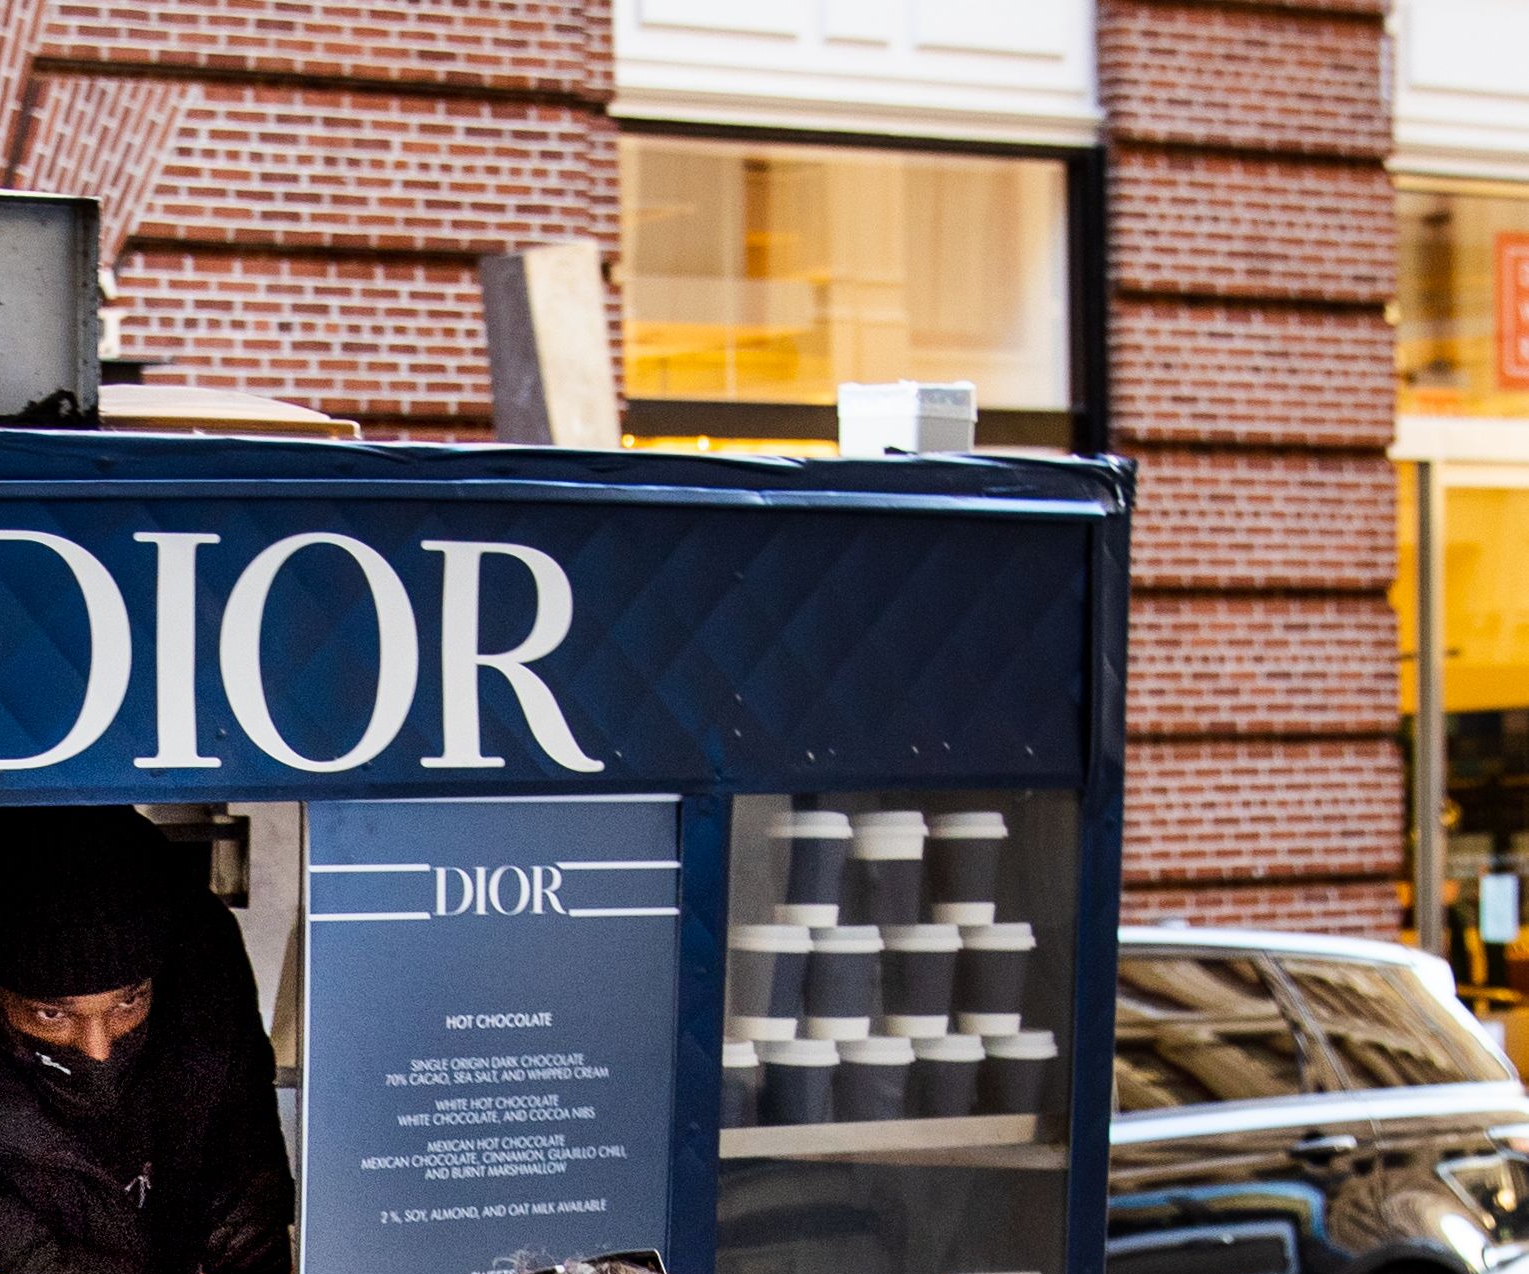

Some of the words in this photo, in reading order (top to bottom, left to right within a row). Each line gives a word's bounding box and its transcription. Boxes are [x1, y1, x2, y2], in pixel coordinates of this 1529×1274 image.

[434, 866, 570, 916] DIOR
[445, 1014, 473, 1030] HOT
[475, 1012, 553, 1029] CHOCOLATE
[410, 1058, 449, 1072] SINGLE
[450, 1057, 489, 1070] ORIGIN
[491, 1055, 519, 1069] DARK
[521, 1052, 585, 1068] CHOCOLATE
[453, 1071, 472, 1085] SEA
[500, 1068, 525, 1083] AND
[527, 1067, 572, 1081] WHIPPED
[573, 1066, 610, 1080] CREAM
[435, 1098, 469, 1111] WHITE
[471, 1097, 494, 1110] HOT
[495, 1094, 559, 1110] CHOCOLATE
[397, 1113, 431, 1126] WHITE
[502, 1109, 527, 1122] AND
[529, 1107, 570, 1121] COCOA
[571, 1106, 596, 1119] NIBS
[427, 1139, 475, 1153] MEXICAN
[476, 1137, 500, 1150] HOT
[501, 1133, 565, 1149] CHOCOLATE
[361, 1155, 410, 1170] MEXICAN
[425, 1166, 450, 1180] AND
[451, 1165, 486, 1179] BURNT
[487, 1161, 567, 1177] MARSHMALLOW
[381, 1210, 388, 1224] 2
[481, 1204, 507, 1218] AND
[507, 1203, 531, 1217] OAT
[531, 1201, 556, 1215] MILK
[556, 1199, 607, 1214] AVAILABLE
